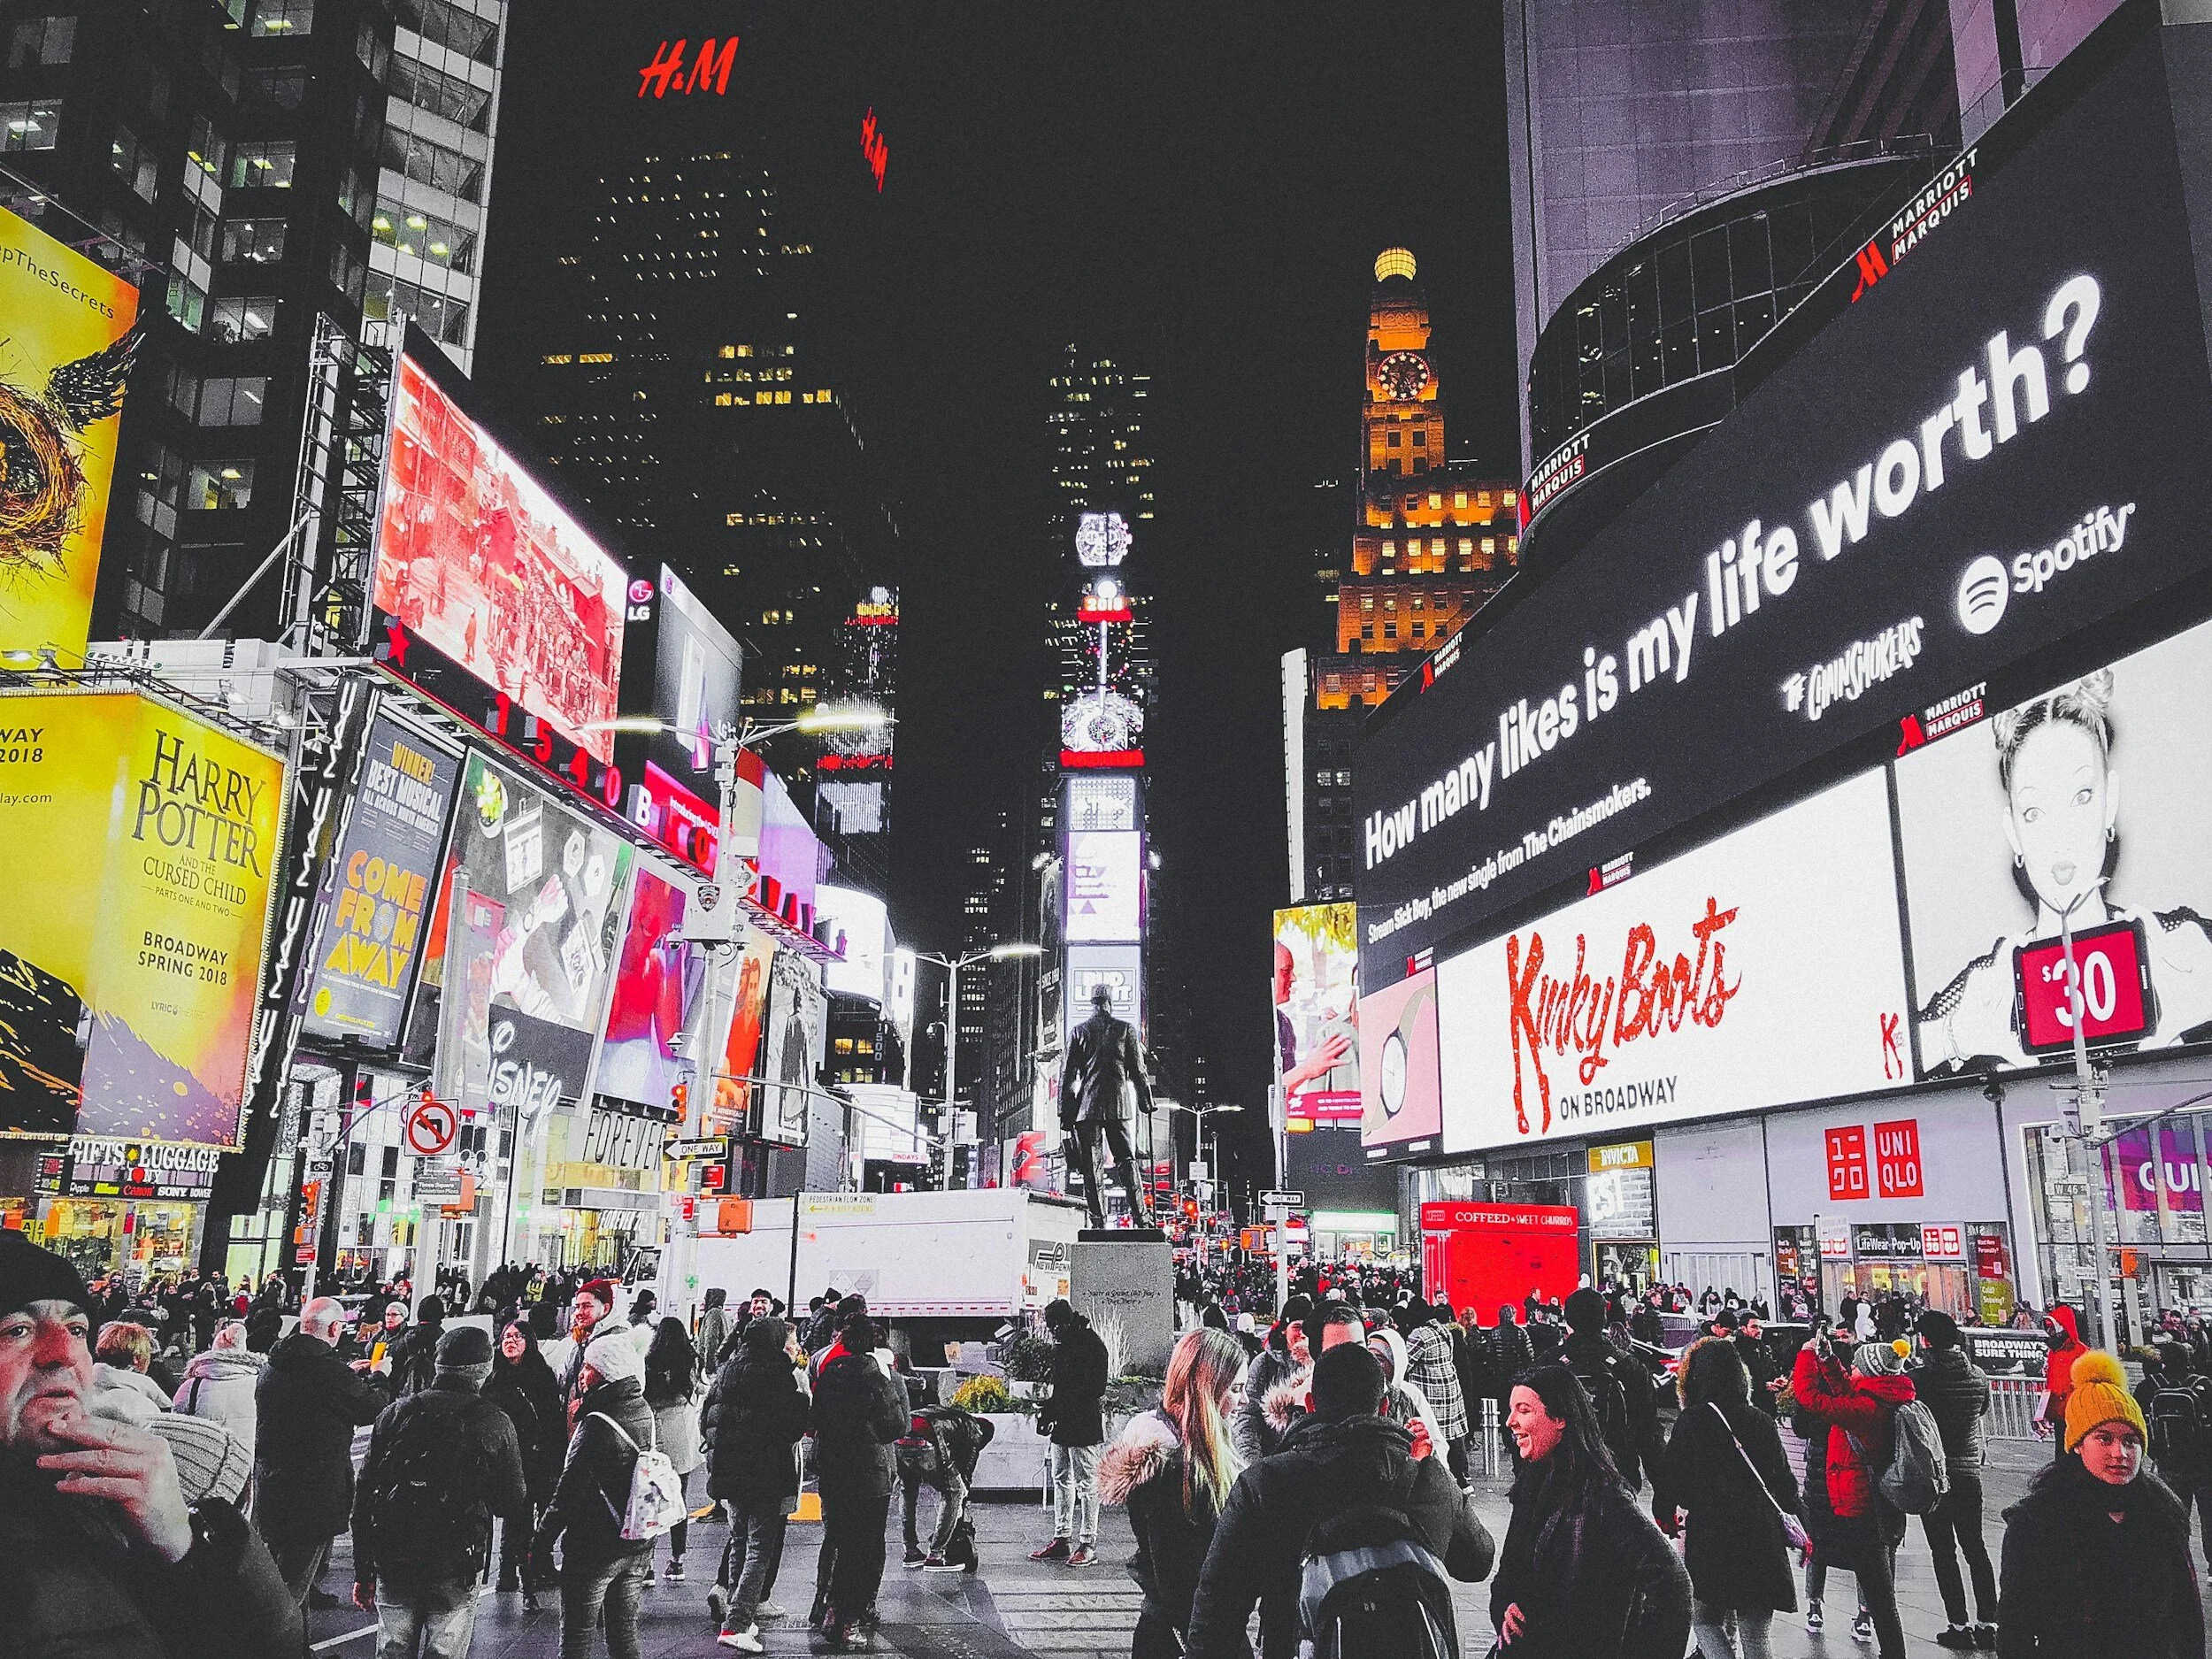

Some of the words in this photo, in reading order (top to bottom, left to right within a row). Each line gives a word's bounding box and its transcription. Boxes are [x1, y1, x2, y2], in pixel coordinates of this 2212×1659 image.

[638, 36, 739, 99] H&M
[1892, 148, 1978, 238] MARRIOTT
[1894, 181, 1970, 260] MARQUIS
[0, 245, 114, 319] pTheSecrets
[1531, 434, 1590, 492] MARRIOTT
[1532, 459, 1583, 511] MARQUIS
[2013, 503, 2130, 593] Spotify
[1365, 800, 1416, 870] How
[1419, 741, 1495, 833] many
[1499, 684, 1578, 780] likes
[1583, 646, 1618, 722] is
[1626, 592, 1698, 684] my
[1707, 518, 1799, 638] life
[1809, 275, 2101, 562] worth?
[627, 607, 649, 620] LG
[1434, 632, 1463, 664] MARRIOTT
[1434, 649, 1460, 679] MARQUIS
[1925, 682, 1987, 721] MARRIOTT
[1927, 702, 1982, 737] MARQUIS
[0, 748, 43, 764] 2018
[150, 728, 266, 826] HARRY
[366, 758, 399, 798] BEST
[396, 773, 442, 822] MUSICAL
[362, 788, 374, 806] ALL
[132, 779, 264, 879] POTTER
[179, 855, 199, 869] AND
[200, 861, 216, 875] THE
[1368, 921, 1394, 945] Stream
[1394, 904, 1413, 930] Sick
[1413, 899, 1432, 921] Boy,
[1432, 887, 1448, 910] the
[1447, 877, 1468, 902] new
[1468, 857, 1497, 890] single
[1496, 845, 1524, 875] from
[1523, 831, 1548, 860] The
[1548, 777, 1652, 847] Chainsmokers.
[1602, 851, 1634, 874] MARRIOTT
[1602, 865, 1632, 886] MARQUIS
[143, 856, 200, 890] CURSED
[204, 877, 247, 905] CHILD
[346, 849, 428, 913] COME
[155, 887, 177, 901] PARTS
[179, 894, 194, 906] ONE
[196, 899, 211, 911] AND
[213, 904, 230, 917] TWO
[334, 887, 419, 952] FROM
[143, 931, 228, 966] BROADWAY
[324, 932, 411, 990] AWAY
[138, 950, 194, 978] SPRING
[199, 966, 227, 986] 2018
[151, 1001, 173, 1014] LYRIC
[1506, 931, 1616, 1136] Kinky
[1613, 895, 1743, 1048] Boots
[1561, 1095, 1581, 1121] ON
[1585, 1075, 1678, 1118] BROADWAY
[68, 1141, 126, 1166] GIFTS
[139, 1145, 221, 1172] LUGGAGE
[681, 1145, 699, 1154] ONE
[702, 1143, 720, 1153] WAY
[1600, 1146, 1640, 1167] INVICTA
[1879, 1130, 1912, 1157] UNI
[123, 1185, 155, 1197] Canon
[157, 1187, 187, 1198] SONY
[1882, 1162, 1917, 1193] QLO
[2055, 1185, 2063, 1194] W
[2067, 1185, 2078, 1194] 46
[1455, 1211, 1510, 1224] COFFEED
[1516, 1215, 1539, 1225] SWEET
[1540, 1216, 1573, 1226] CHURROS
[1856, 1237, 1890, 1252] LifeWear
[1892, 1237, 1922, 1254] Pop-Up
[1036, 1260, 1052, 1271] NEW
[1974, 1340, 2048, 1350] BROADWAY'S
[1975, 1348, 2006, 1358] SURE
[2008, 1349, 2044, 1359] THING
